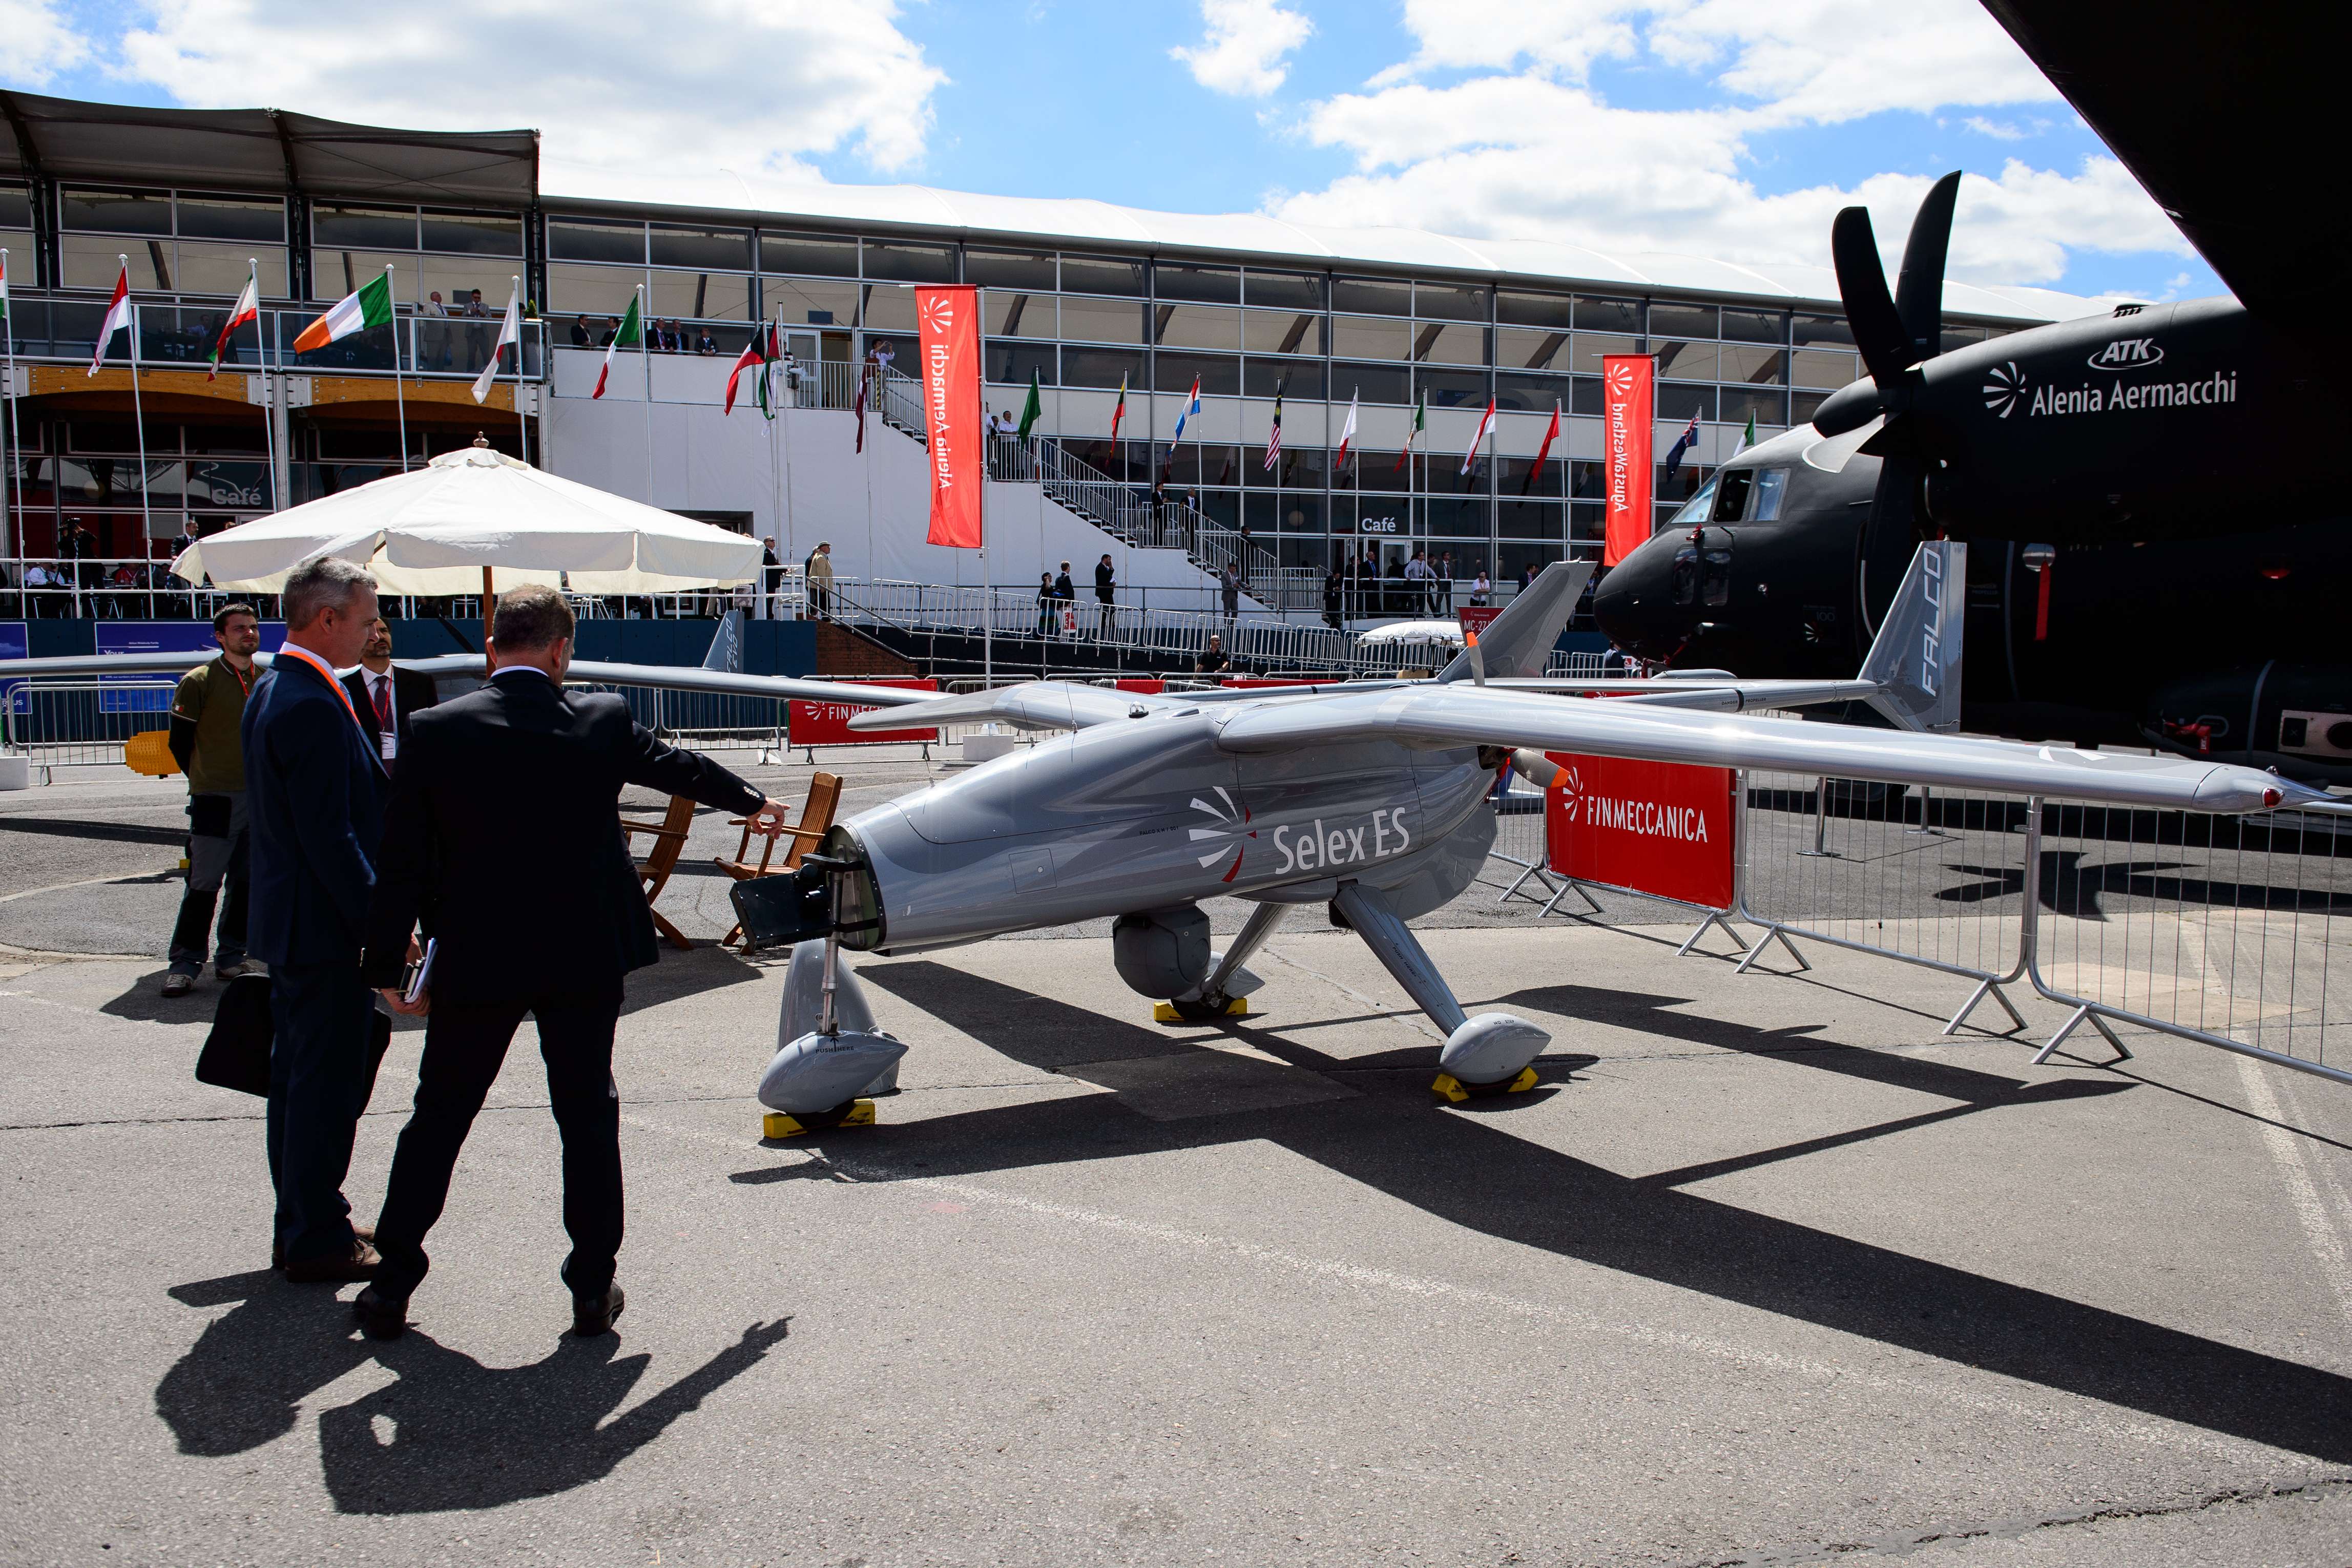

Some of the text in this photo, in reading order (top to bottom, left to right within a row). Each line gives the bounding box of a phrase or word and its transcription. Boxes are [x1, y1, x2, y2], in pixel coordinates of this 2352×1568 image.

[2100, 338, 2154, 363] ATK
[2030, 371, 2237, 416] Alenia Aermacchi
[212, 488, 262, 505] Café
[1362, 517, 1396, 532] Café
[1922, 547, 1941, 697] FALCO
[1274, 807, 1410, 874] Selex ES
[1588, 796, 1708, 843] FINMECCANICA
